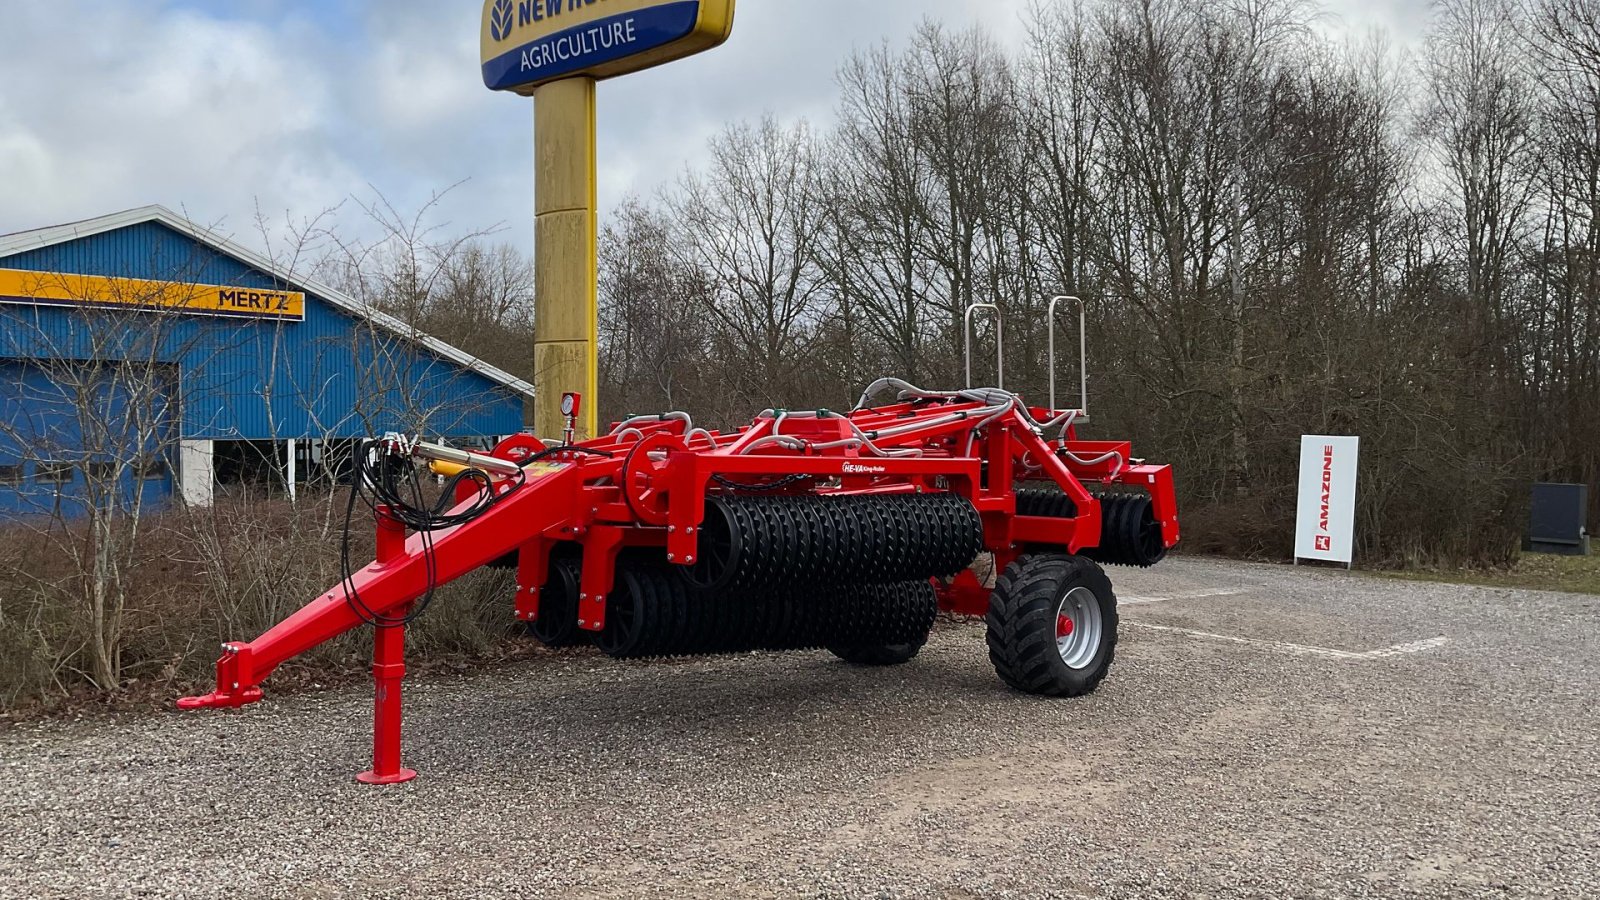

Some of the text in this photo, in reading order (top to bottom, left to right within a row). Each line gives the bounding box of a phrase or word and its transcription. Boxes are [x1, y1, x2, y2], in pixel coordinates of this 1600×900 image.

[519, 0, 562, 27] NEW
[520, 18, 636, 72] AGRICULTURE
[219, 290, 288, 310] MERTZ
[844, 464, 864, 473] HE-VA
[1319, 445, 1333, 532] AMAZONE
